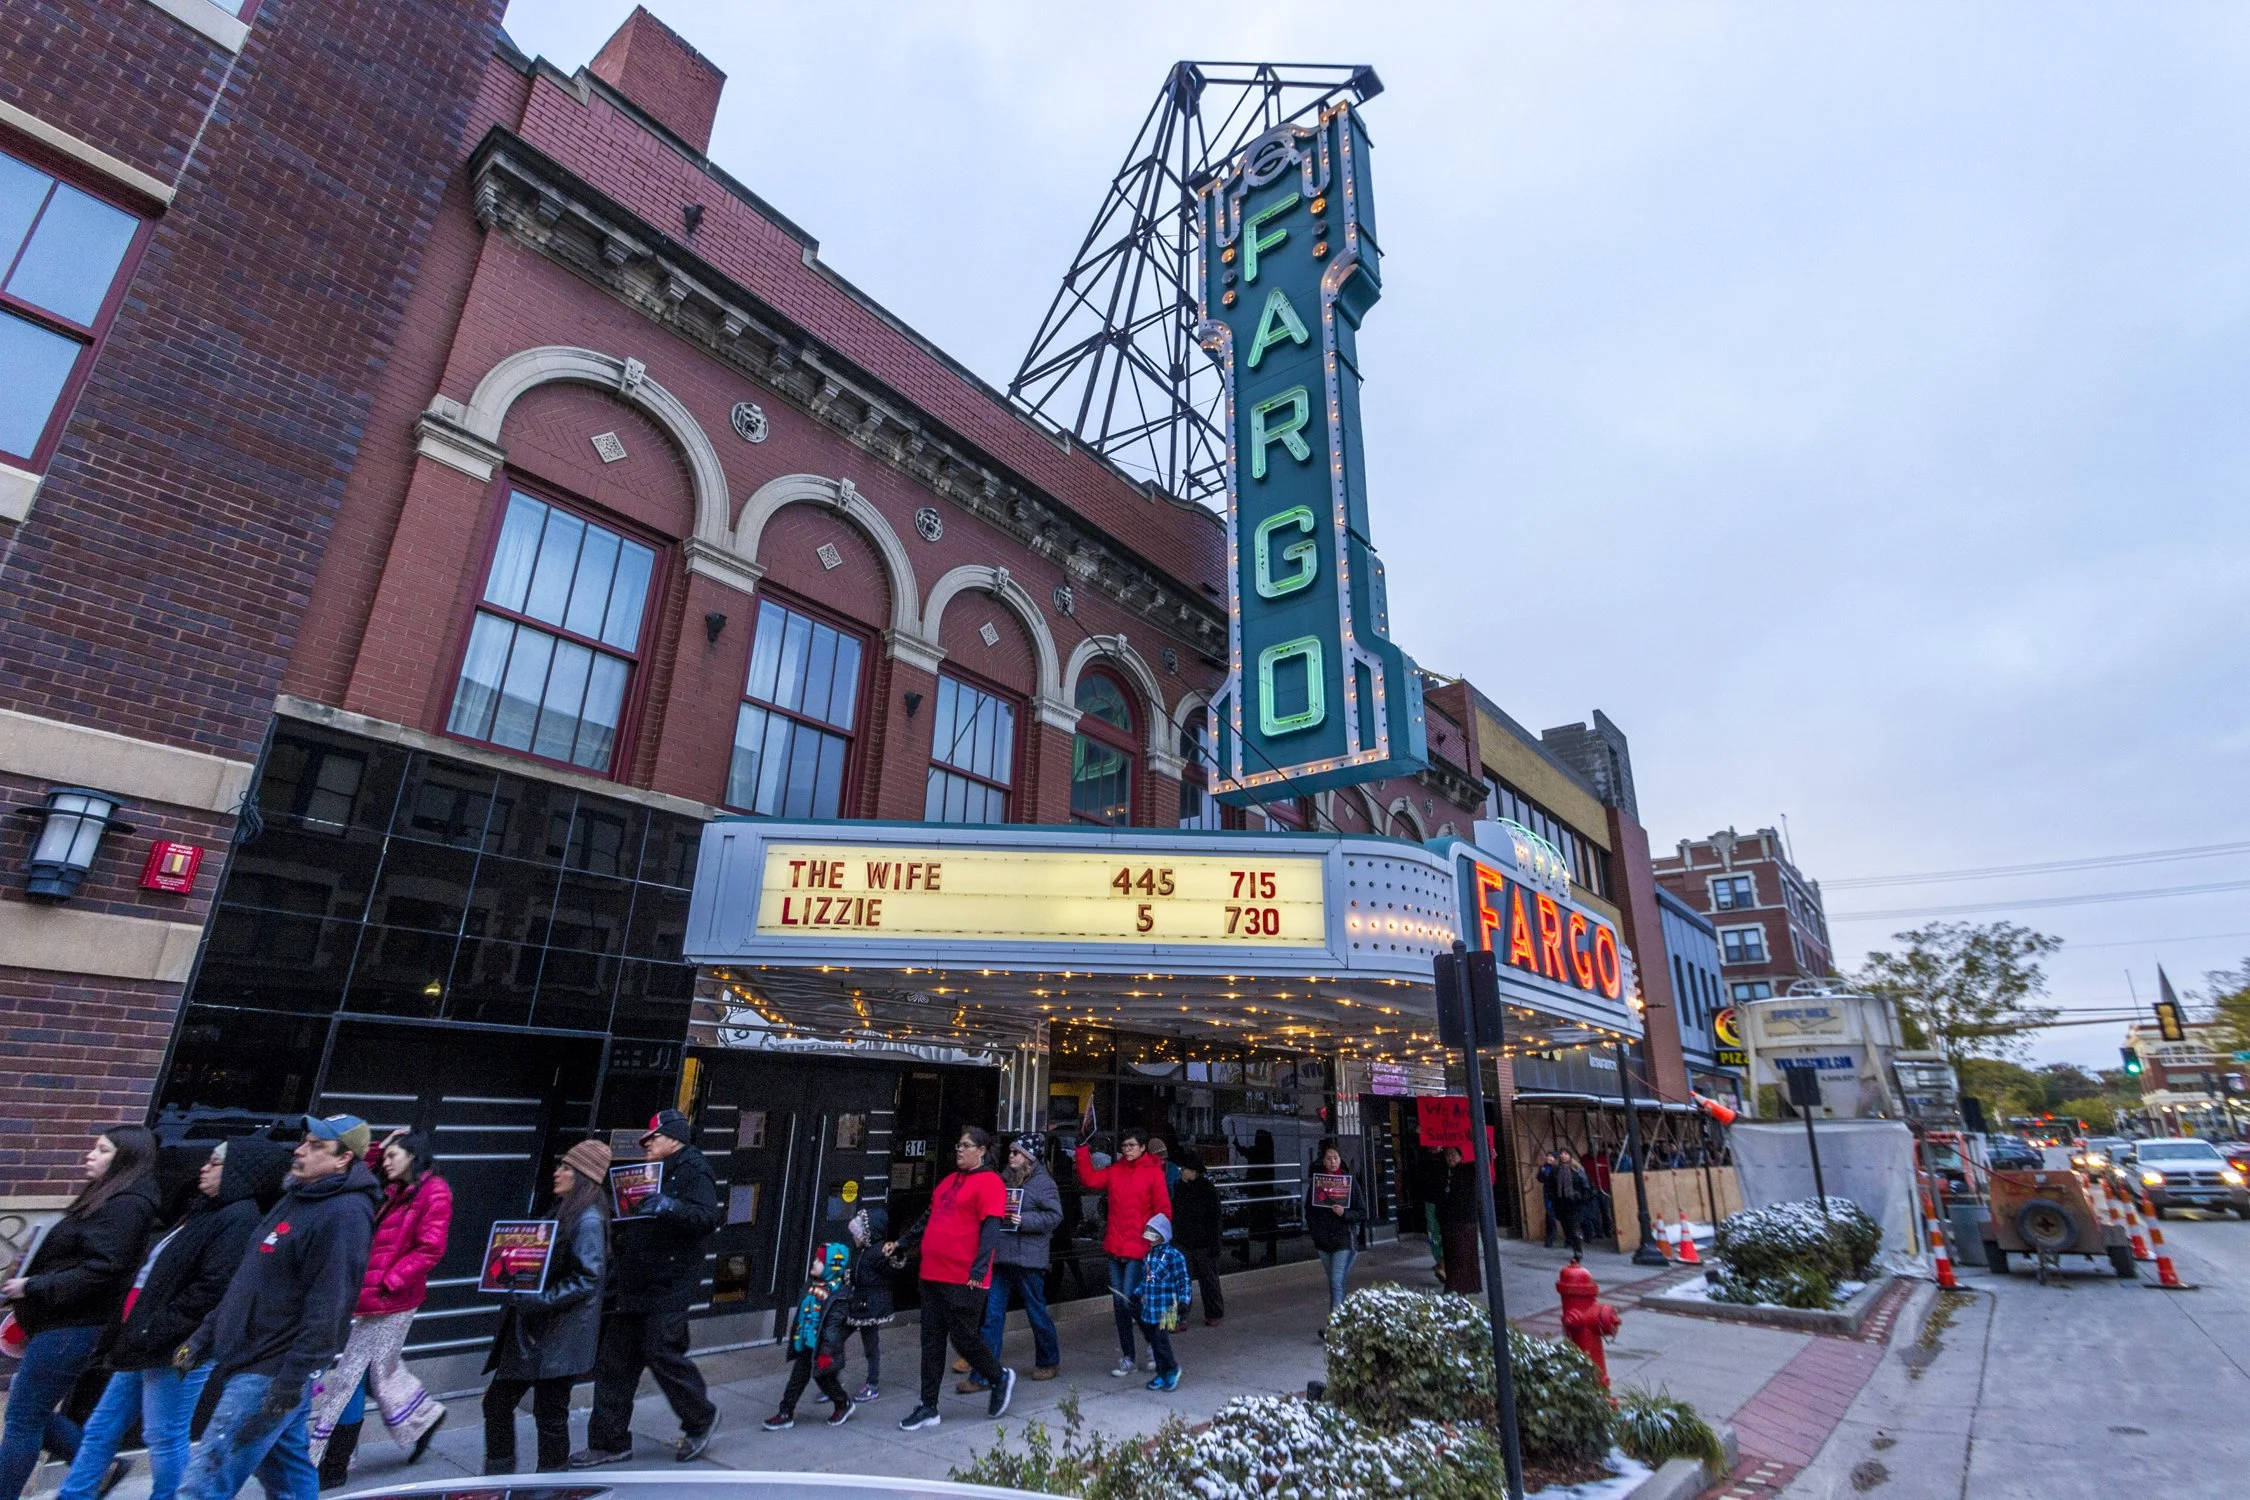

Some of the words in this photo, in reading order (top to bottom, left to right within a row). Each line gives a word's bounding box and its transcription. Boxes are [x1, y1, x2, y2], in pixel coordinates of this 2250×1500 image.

[1244, 192, 1326, 738] FARGO
[789, 860, 845, 889] THE
[866, 861, 942, 891] WIFE
[1112, 867, 1175, 896] 445
[1230, 871, 1276, 899] 715
[781, 896, 883, 927] LIZZIE
[1136, 903, 1154, 933] 5
[1225, 906, 1280, 936] 730
[1475, 860, 1621, 1000] FARGO
[906, 1141, 925, 1155] 314
